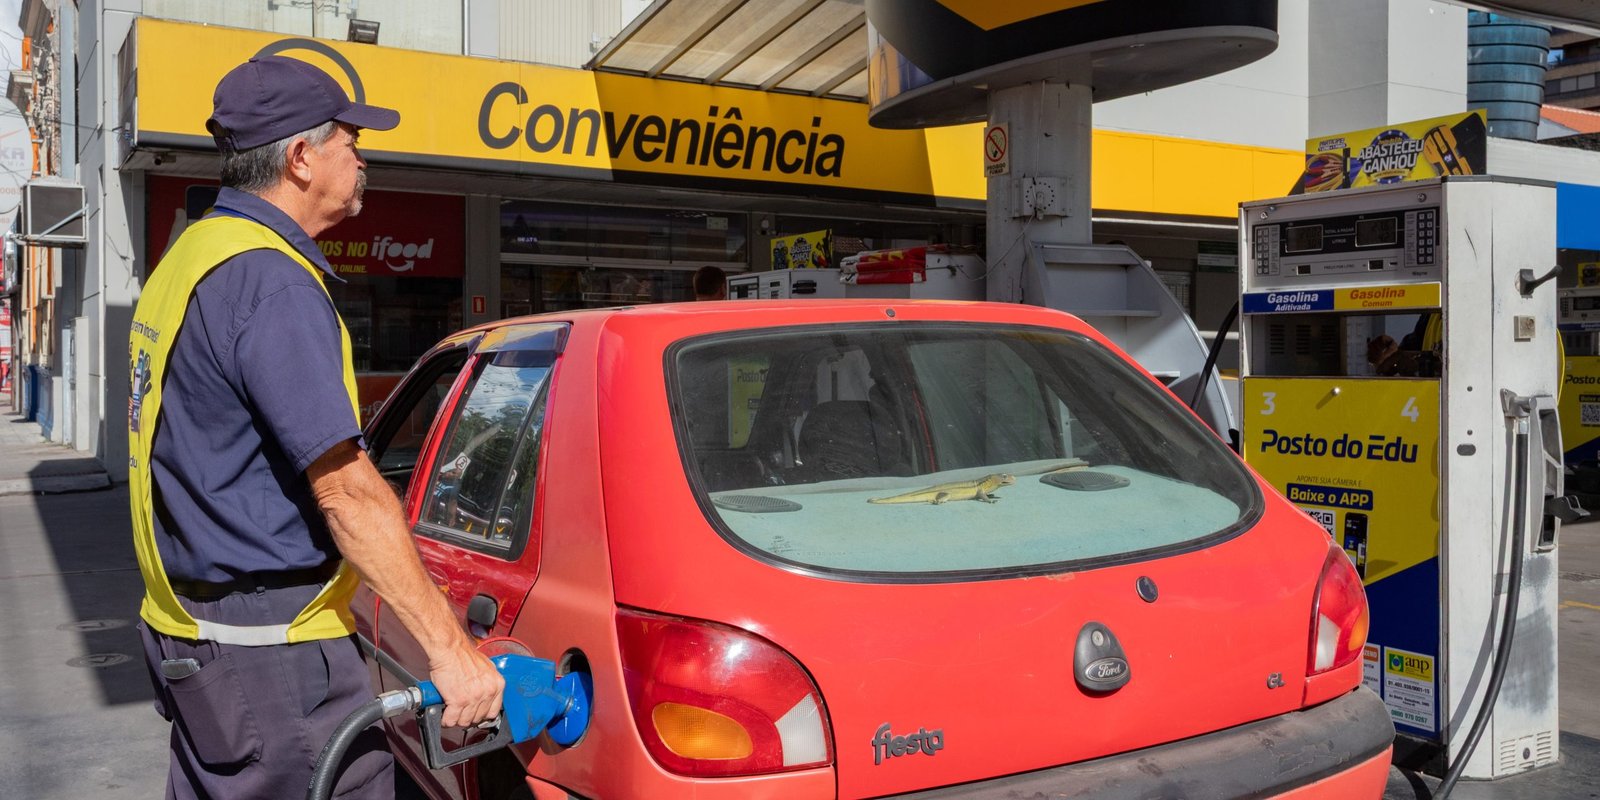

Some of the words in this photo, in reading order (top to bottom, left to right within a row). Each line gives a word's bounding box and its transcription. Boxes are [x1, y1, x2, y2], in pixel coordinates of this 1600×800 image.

[477, 81, 845, 178] Conveniência
[1357, 140, 1424, 161] ABASTECEU
[1364, 152, 1417, 173] GANHOU
[347, 241, 368, 257] NO
[339, 264, 368, 274] ONLINE.
[1267, 292, 1319, 304] Gasolina
[1350, 287, 1406, 300] Gasolina
[1275, 303, 1311, 312] Aditivada
[1362, 300, 1393, 308] Comum
[737, 368, 759, 383] Posto
[1565, 374, 1595, 385] Posto
[1260, 392, 1276, 416] 3
[1401, 397, 1419, 423] 4
[1261, 429, 1328, 457] Posto
[1331, 433, 1363, 459] do
[1366, 435, 1418, 463] Edu
[1296, 475, 1318, 484] APONTE
[1319, 476, 1331, 485] SUA
[1290, 487, 1324, 503] Baixe
[1328, 493, 1337, 504] o
[1339, 492, 1369, 507] APP
[1097, 661, 1122, 679] Ford
[1405, 656, 1430, 674] anp
[1267, 672, 1286, 690] GL
[1391, 709, 1403, 718] 0800
[871, 722, 944, 766] fiesta
